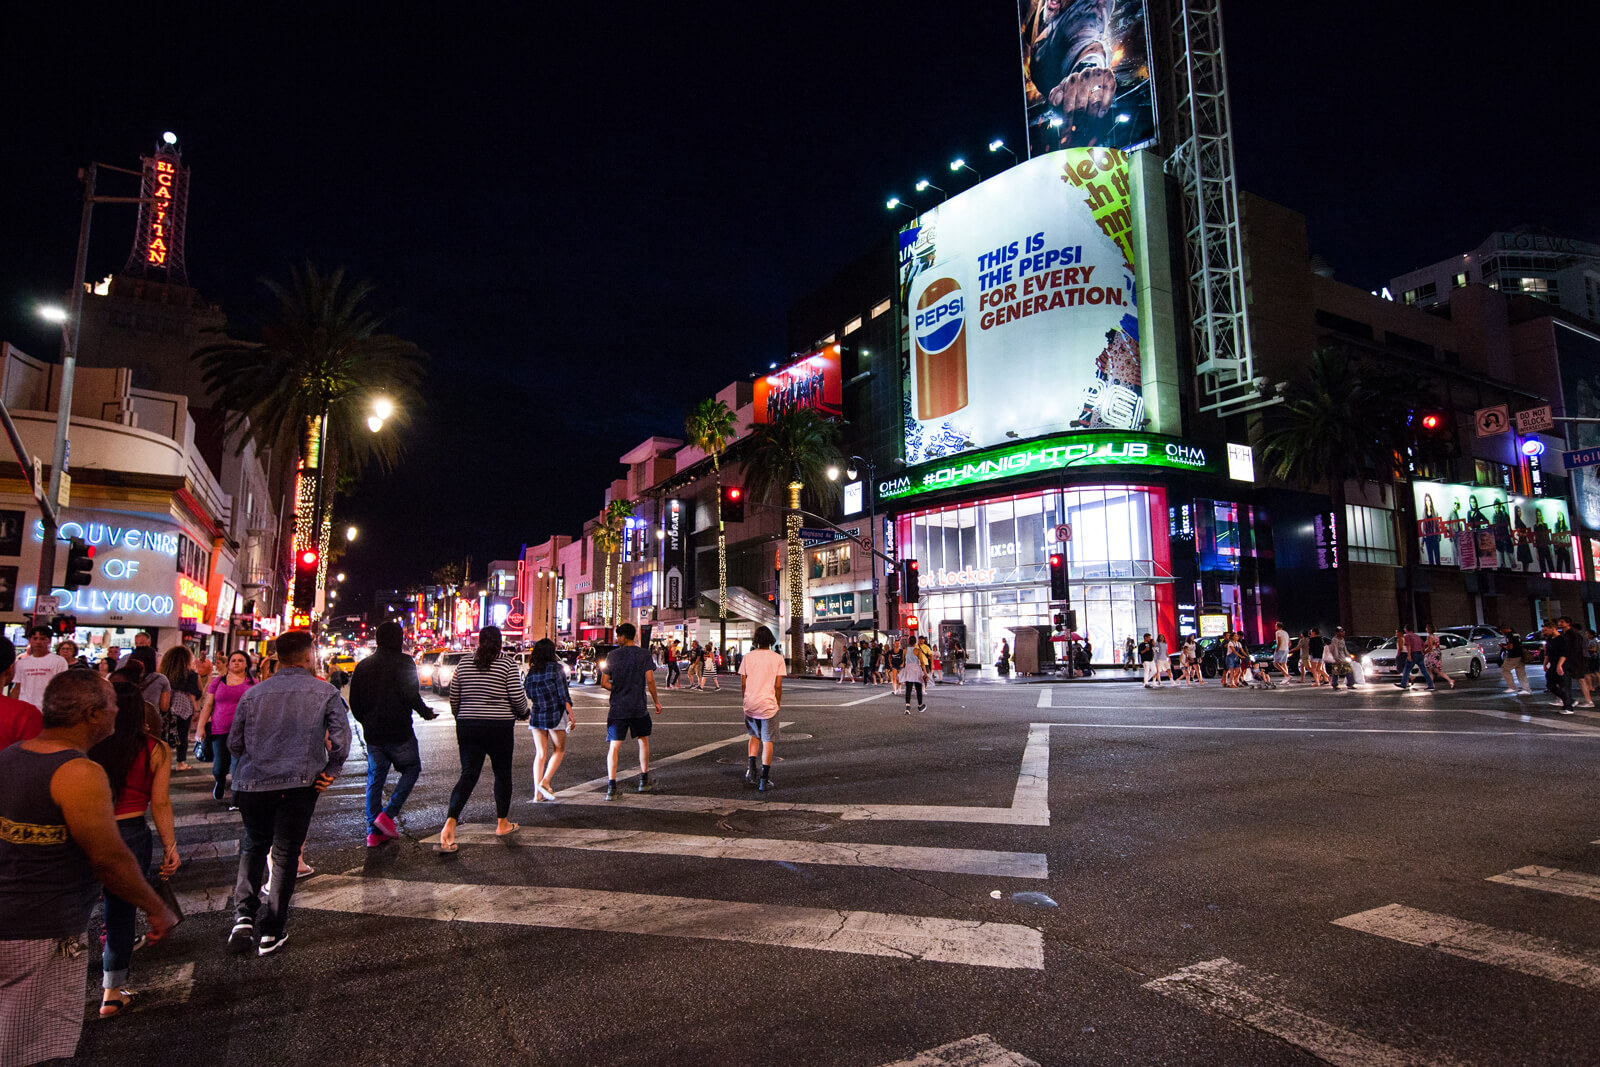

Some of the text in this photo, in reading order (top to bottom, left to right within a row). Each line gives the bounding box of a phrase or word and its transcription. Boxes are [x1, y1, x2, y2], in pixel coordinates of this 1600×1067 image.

[156, 161, 175, 172] EL
[978, 232, 1045, 272] THIS IS
[978, 245, 1082, 291] THE PEPSI
[979, 265, 1096, 312] FOR EVERY
[915, 296, 964, 331] PEPSI
[980, 286, 1128, 330] GENERATION.
[1520, 408, 1546, 420] DO NOT
[1522, 417, 1546, 427] BLOCK
[922, 442, 1149, 486] #OHMNIGHTCLUB
[1165, 443, 1205, 460] OHM
[879, 475, 911, 493] OHM
[35, 519, 178, 555] SOUVENIRS
[104, 558, 140, 579] OF
[938, 565, 997, 586] Locker
[25, 587, 174, 614] HOLLYWOOD
